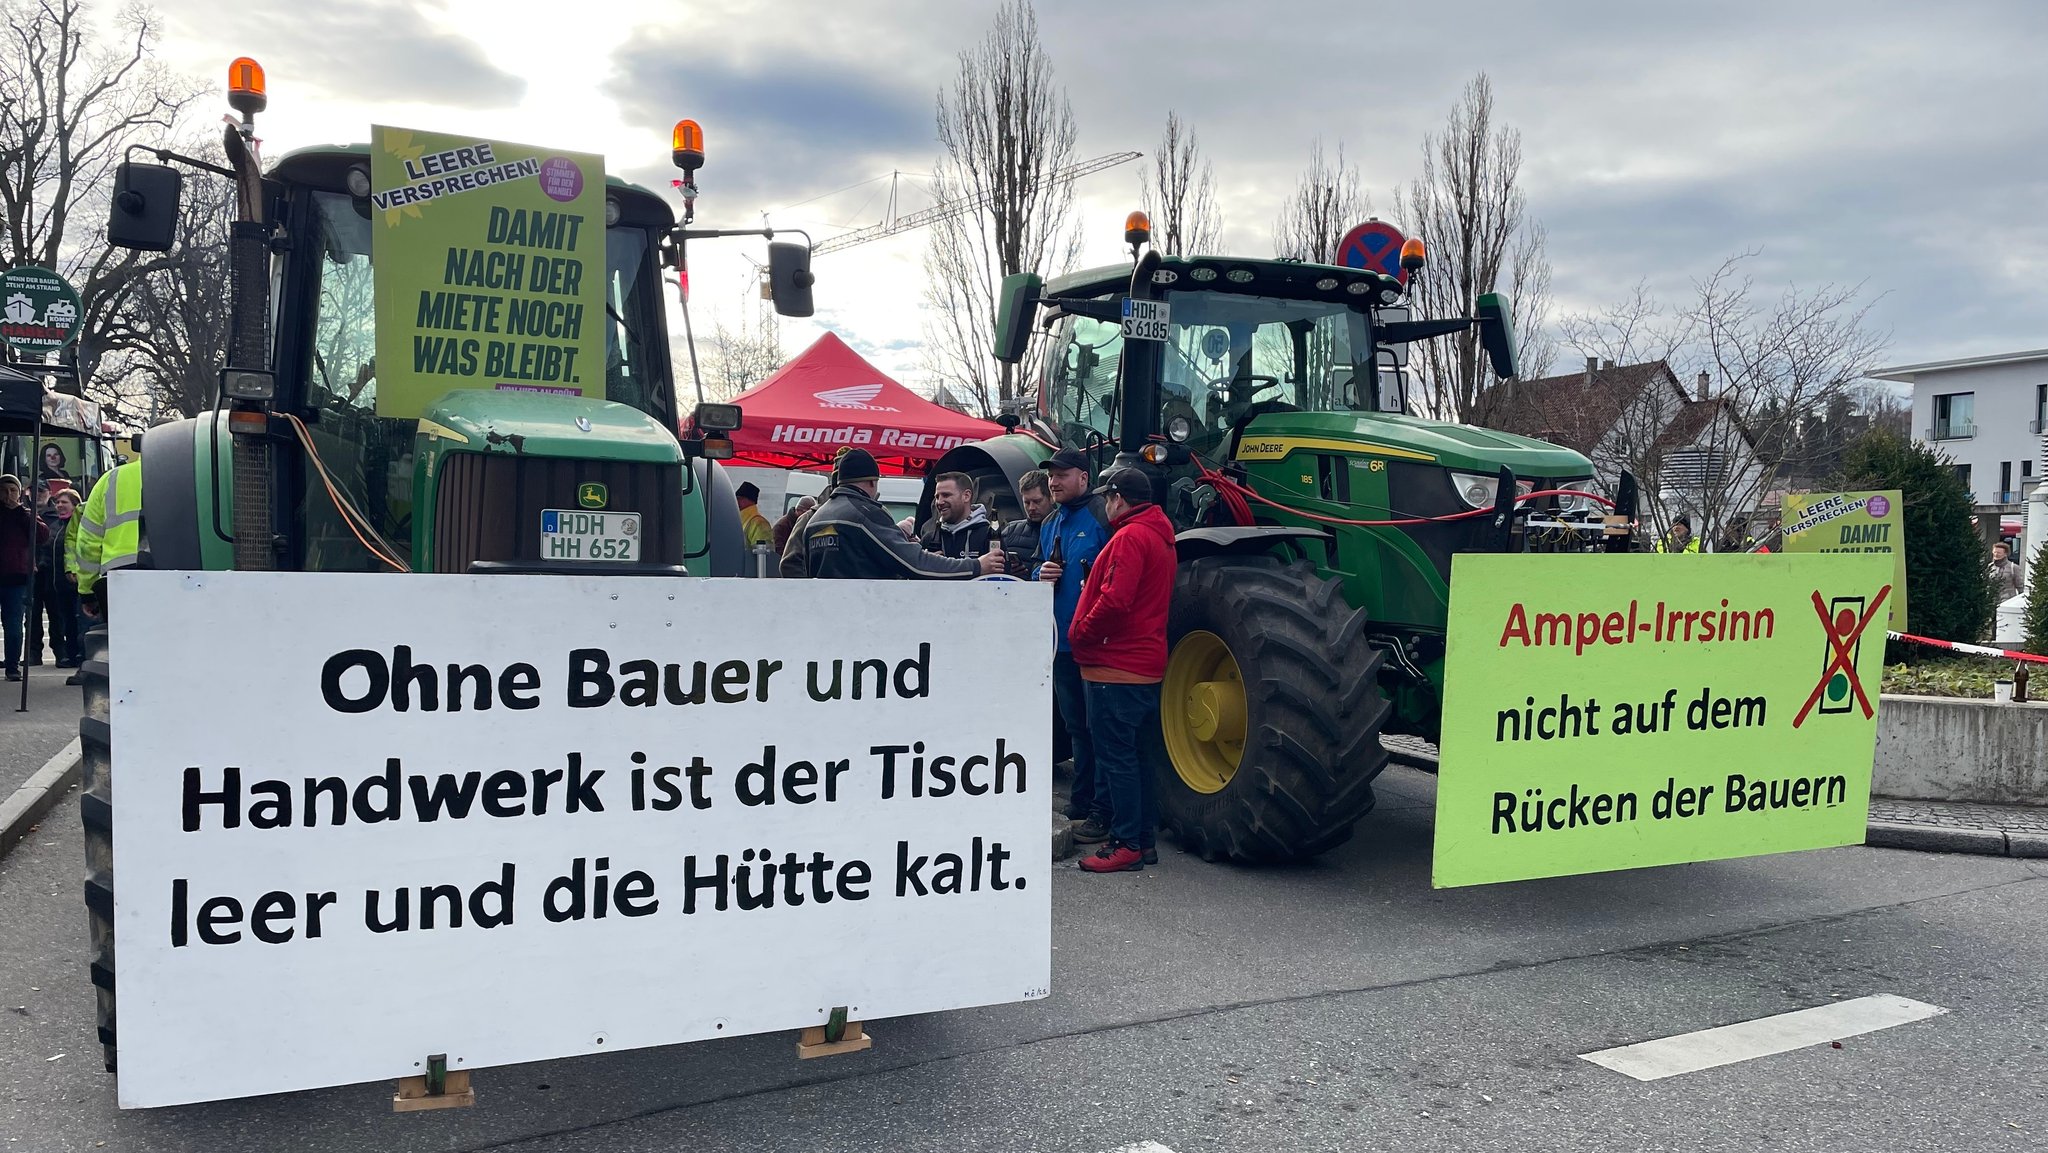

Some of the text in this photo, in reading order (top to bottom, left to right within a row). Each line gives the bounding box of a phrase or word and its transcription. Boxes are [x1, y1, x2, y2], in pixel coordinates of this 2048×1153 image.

[405, 144, 494, 180] LEERE
[373, 158, 540, 210] VERSPRECHEN!
[487, 205, 584, 251] DAMIT
[444, 247, 582, 296] NACH DER
[36, 283, 60, 291] STRAND
[416, 291, 583, 340] MIETE NOCH
[1131, 301, 1157, 319] HDH
[2, 325, 65, 338] HABECK
[9, 336, 31, 344] NICHT
[1124, 320, 1167, 339] S 6185
[414, 336, 579, 383] WAS BLEIBT.
[818, 402, 902, 413] HONDA
[771, 424, 873, 444] Honda
[1242, 442, 1284, 453] JOHN DEERE
[1369, 460, 1385, 472] 6R
[1301, 475, 1313, 484] 185
[1783, 498, 1867, 536] VERSPRECHEN!
[1798, 496, 1843, 519] LEERE
[559, 514, 604, 536] HDH
[1840, 523, 1891, 544] DAMIT
[551, 537, 631, 559] HH 652
[1500, 599, 1774, 656] Ampel-Irrsinn
[321, 642, 931, 713] Ohne Bauer und
[1496, 688, 1767, 741] nicht auf dem
[182, 739, 1027, 832] Handwerk ist der Tisch
[1492, 774, 1846, 834] Rücken der Bauern
[171, 837, 1027, 947] leer und die Hütte kalt.
